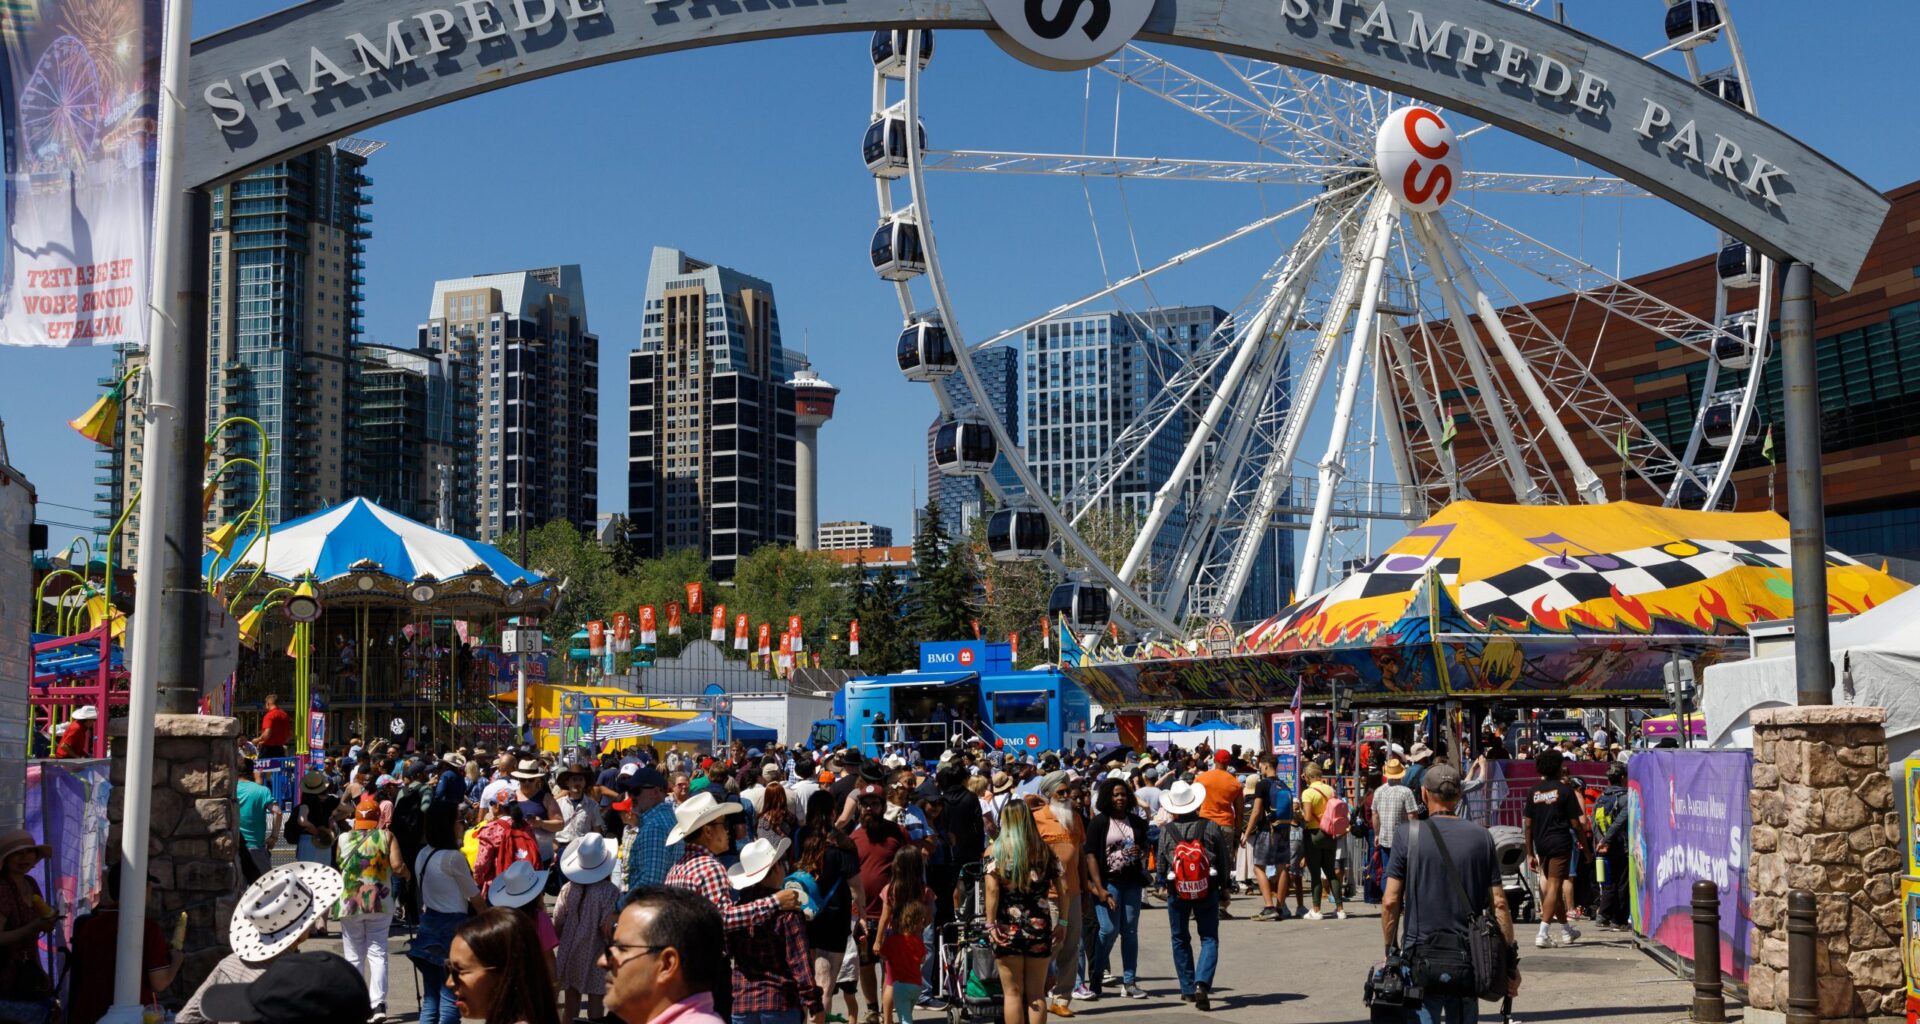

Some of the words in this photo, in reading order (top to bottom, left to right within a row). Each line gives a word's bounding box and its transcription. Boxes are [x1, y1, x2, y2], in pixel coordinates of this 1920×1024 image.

[1633, 98, 1789, 206] PARK
[527, 640, 534, 651] 3
[927, 652, 955, 664] BMO
[509, 661, 545, 677] FNEL
[1281, 724, 1288, 738] 5
[253, 759, 271, 768] XIT
[1674, 843, 1686, 874] TO
[1686, 842, 1712, 882] MAKE
[1711, 857, 1728, 888] YOU
